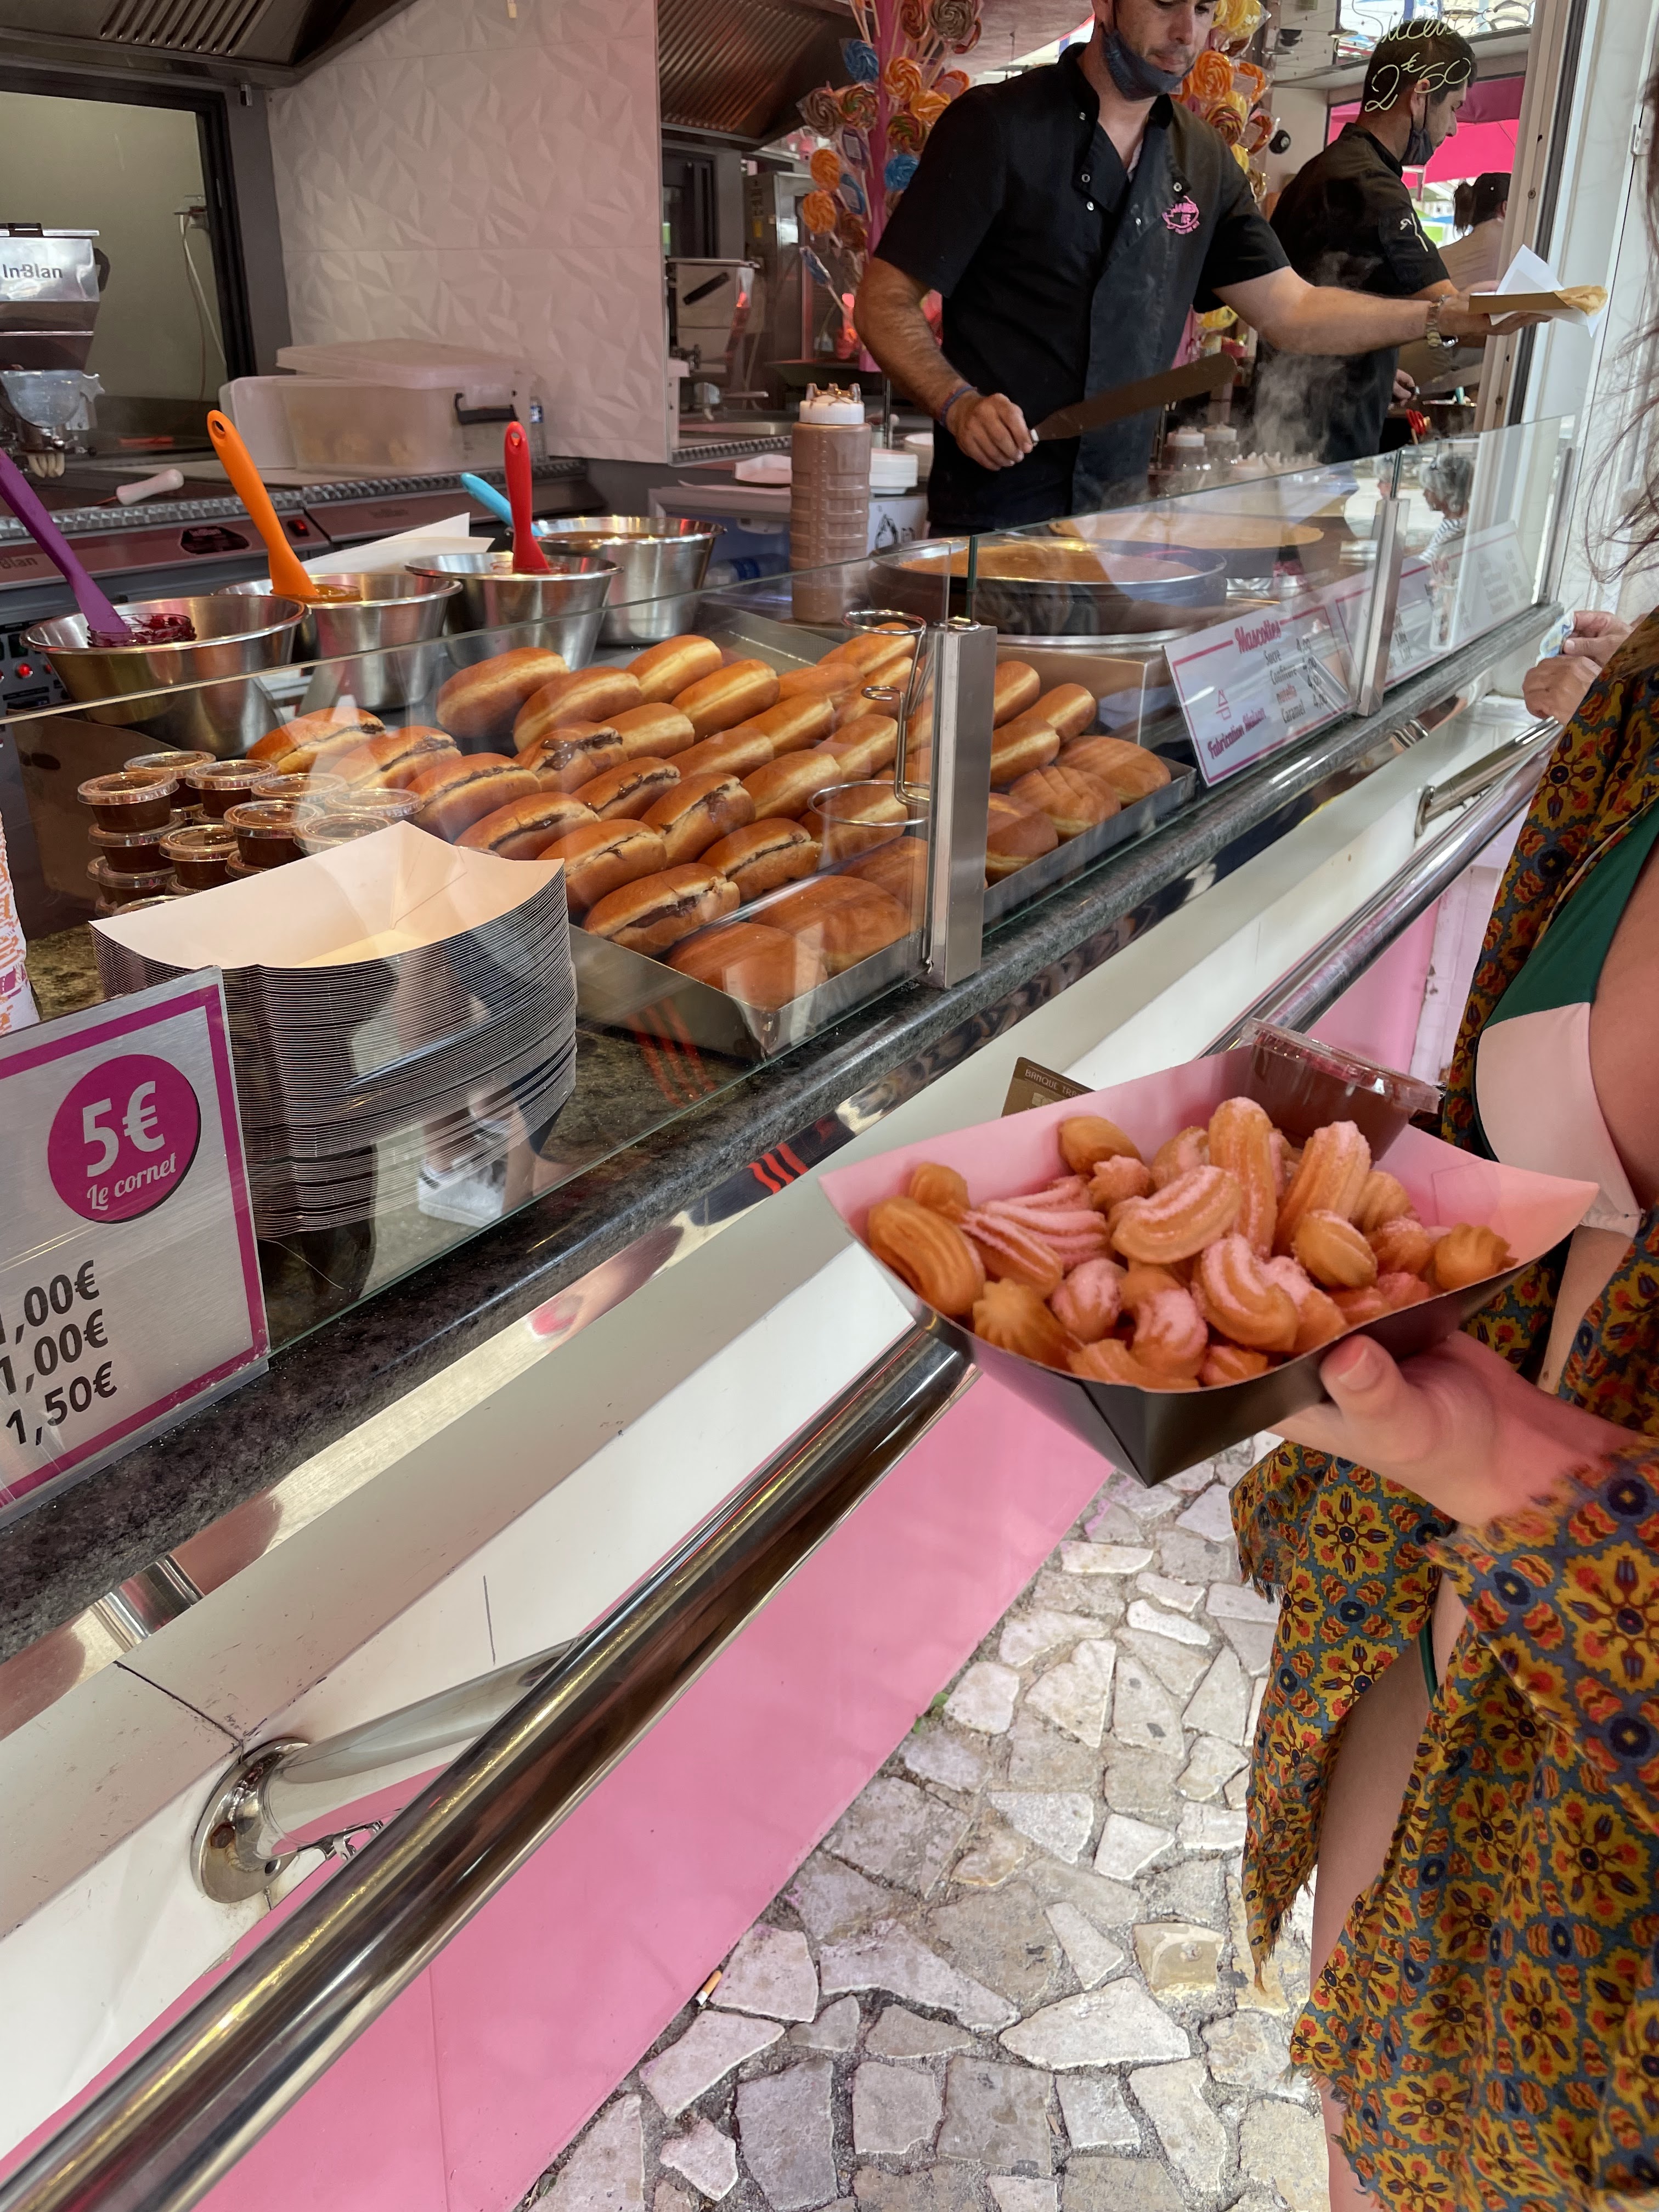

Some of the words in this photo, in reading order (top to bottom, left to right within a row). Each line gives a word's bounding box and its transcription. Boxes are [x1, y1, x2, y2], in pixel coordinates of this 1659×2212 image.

[1281, 698, 1306, 724] Caramel
[1207, 725, 1244, 759] Fabrication
[1025, 1069, 1058, 1091] BANQUE
[82, 1080, 165, 1177] 5€
[87, 1184, 109, 1211] Le
[114, 1152, 177, 1198] cornet
[0, 1308, 109, 1396] 1,00€
[5, 1361, 118, 1446] 1,50€
